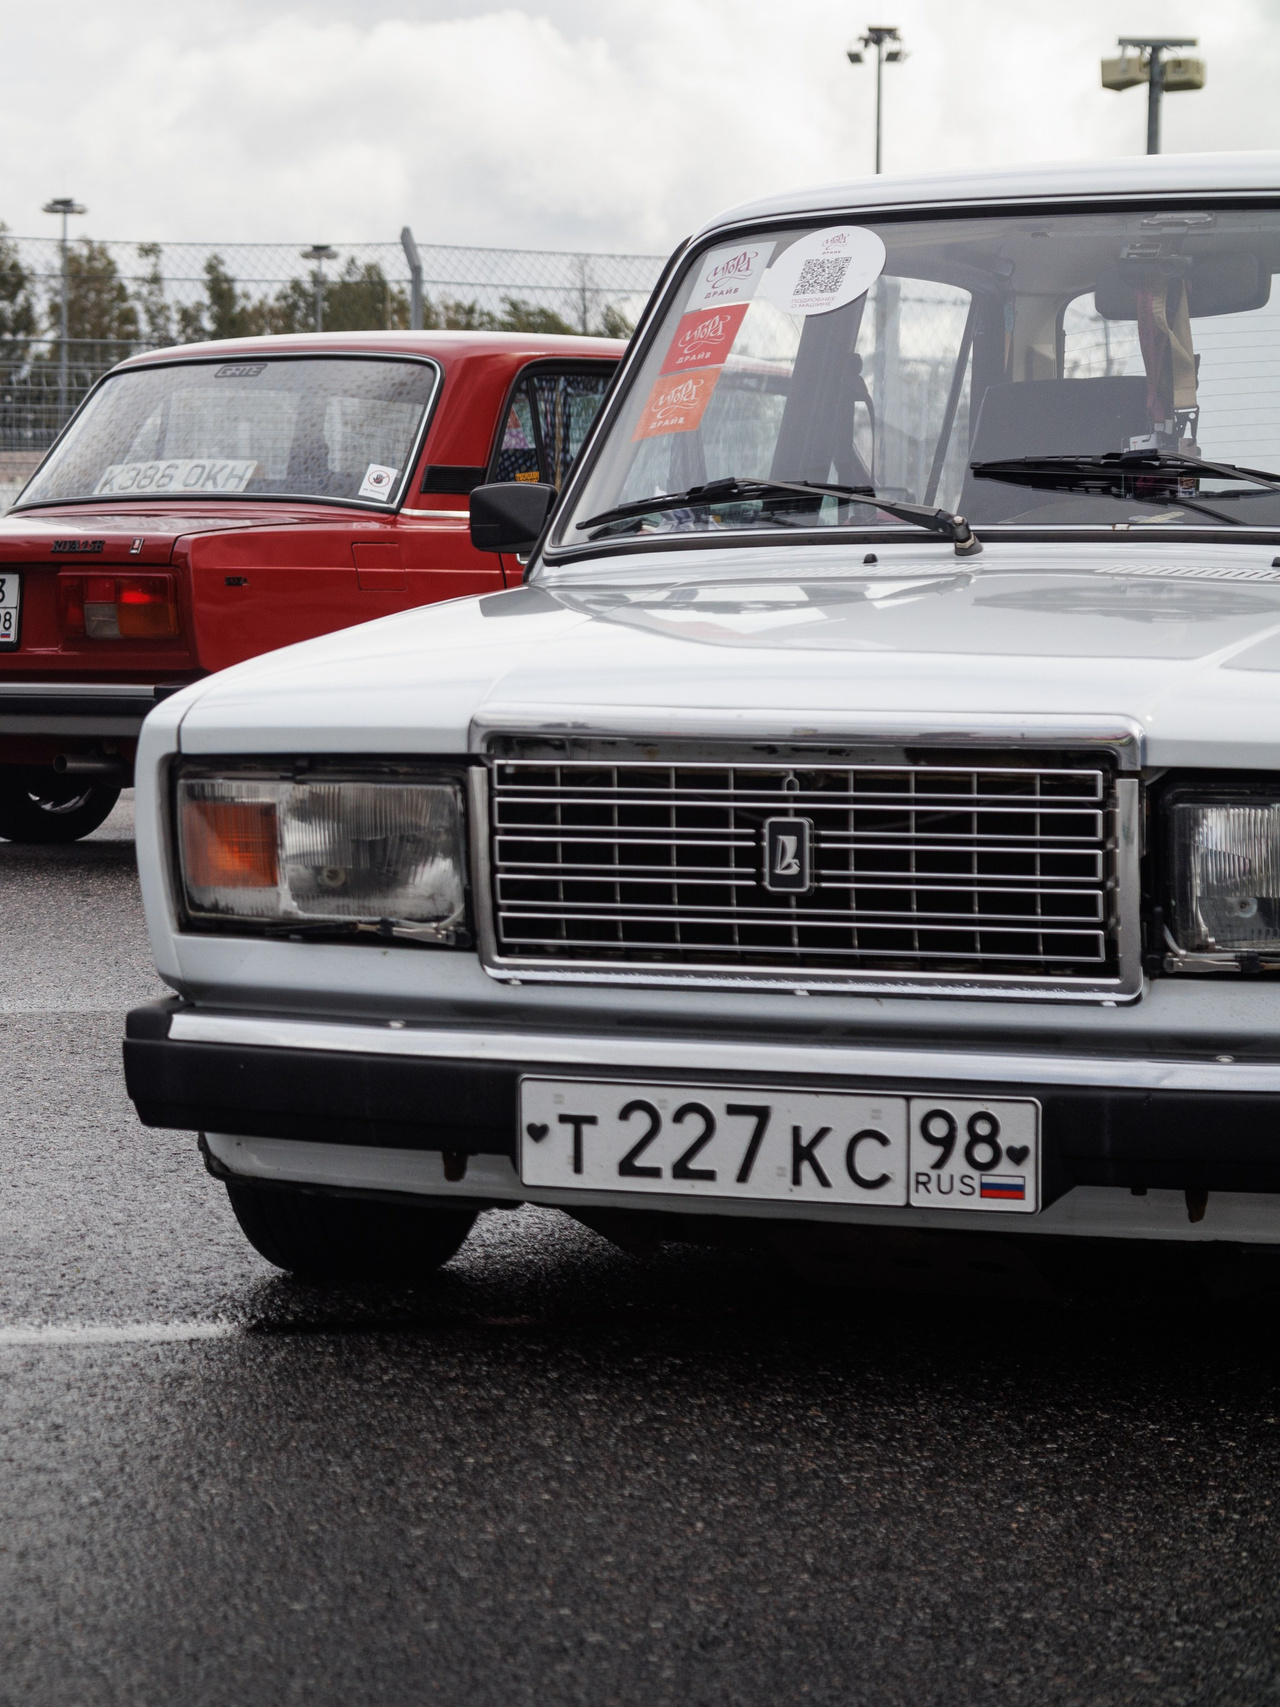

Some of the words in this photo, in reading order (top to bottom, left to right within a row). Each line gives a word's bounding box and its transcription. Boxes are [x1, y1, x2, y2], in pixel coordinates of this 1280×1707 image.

[704, 287, 740, 299] ДРАЙВ
[790, 296, 836, 304] ПОДРОБНЕЕ
[676, 351, 712, 364] ДРАЙВ
[649, 416, 685, 429] ДРАЙВ
[919, 1109, 1004, 1172] 98
[914, 1172, 977, 1197] RUS
